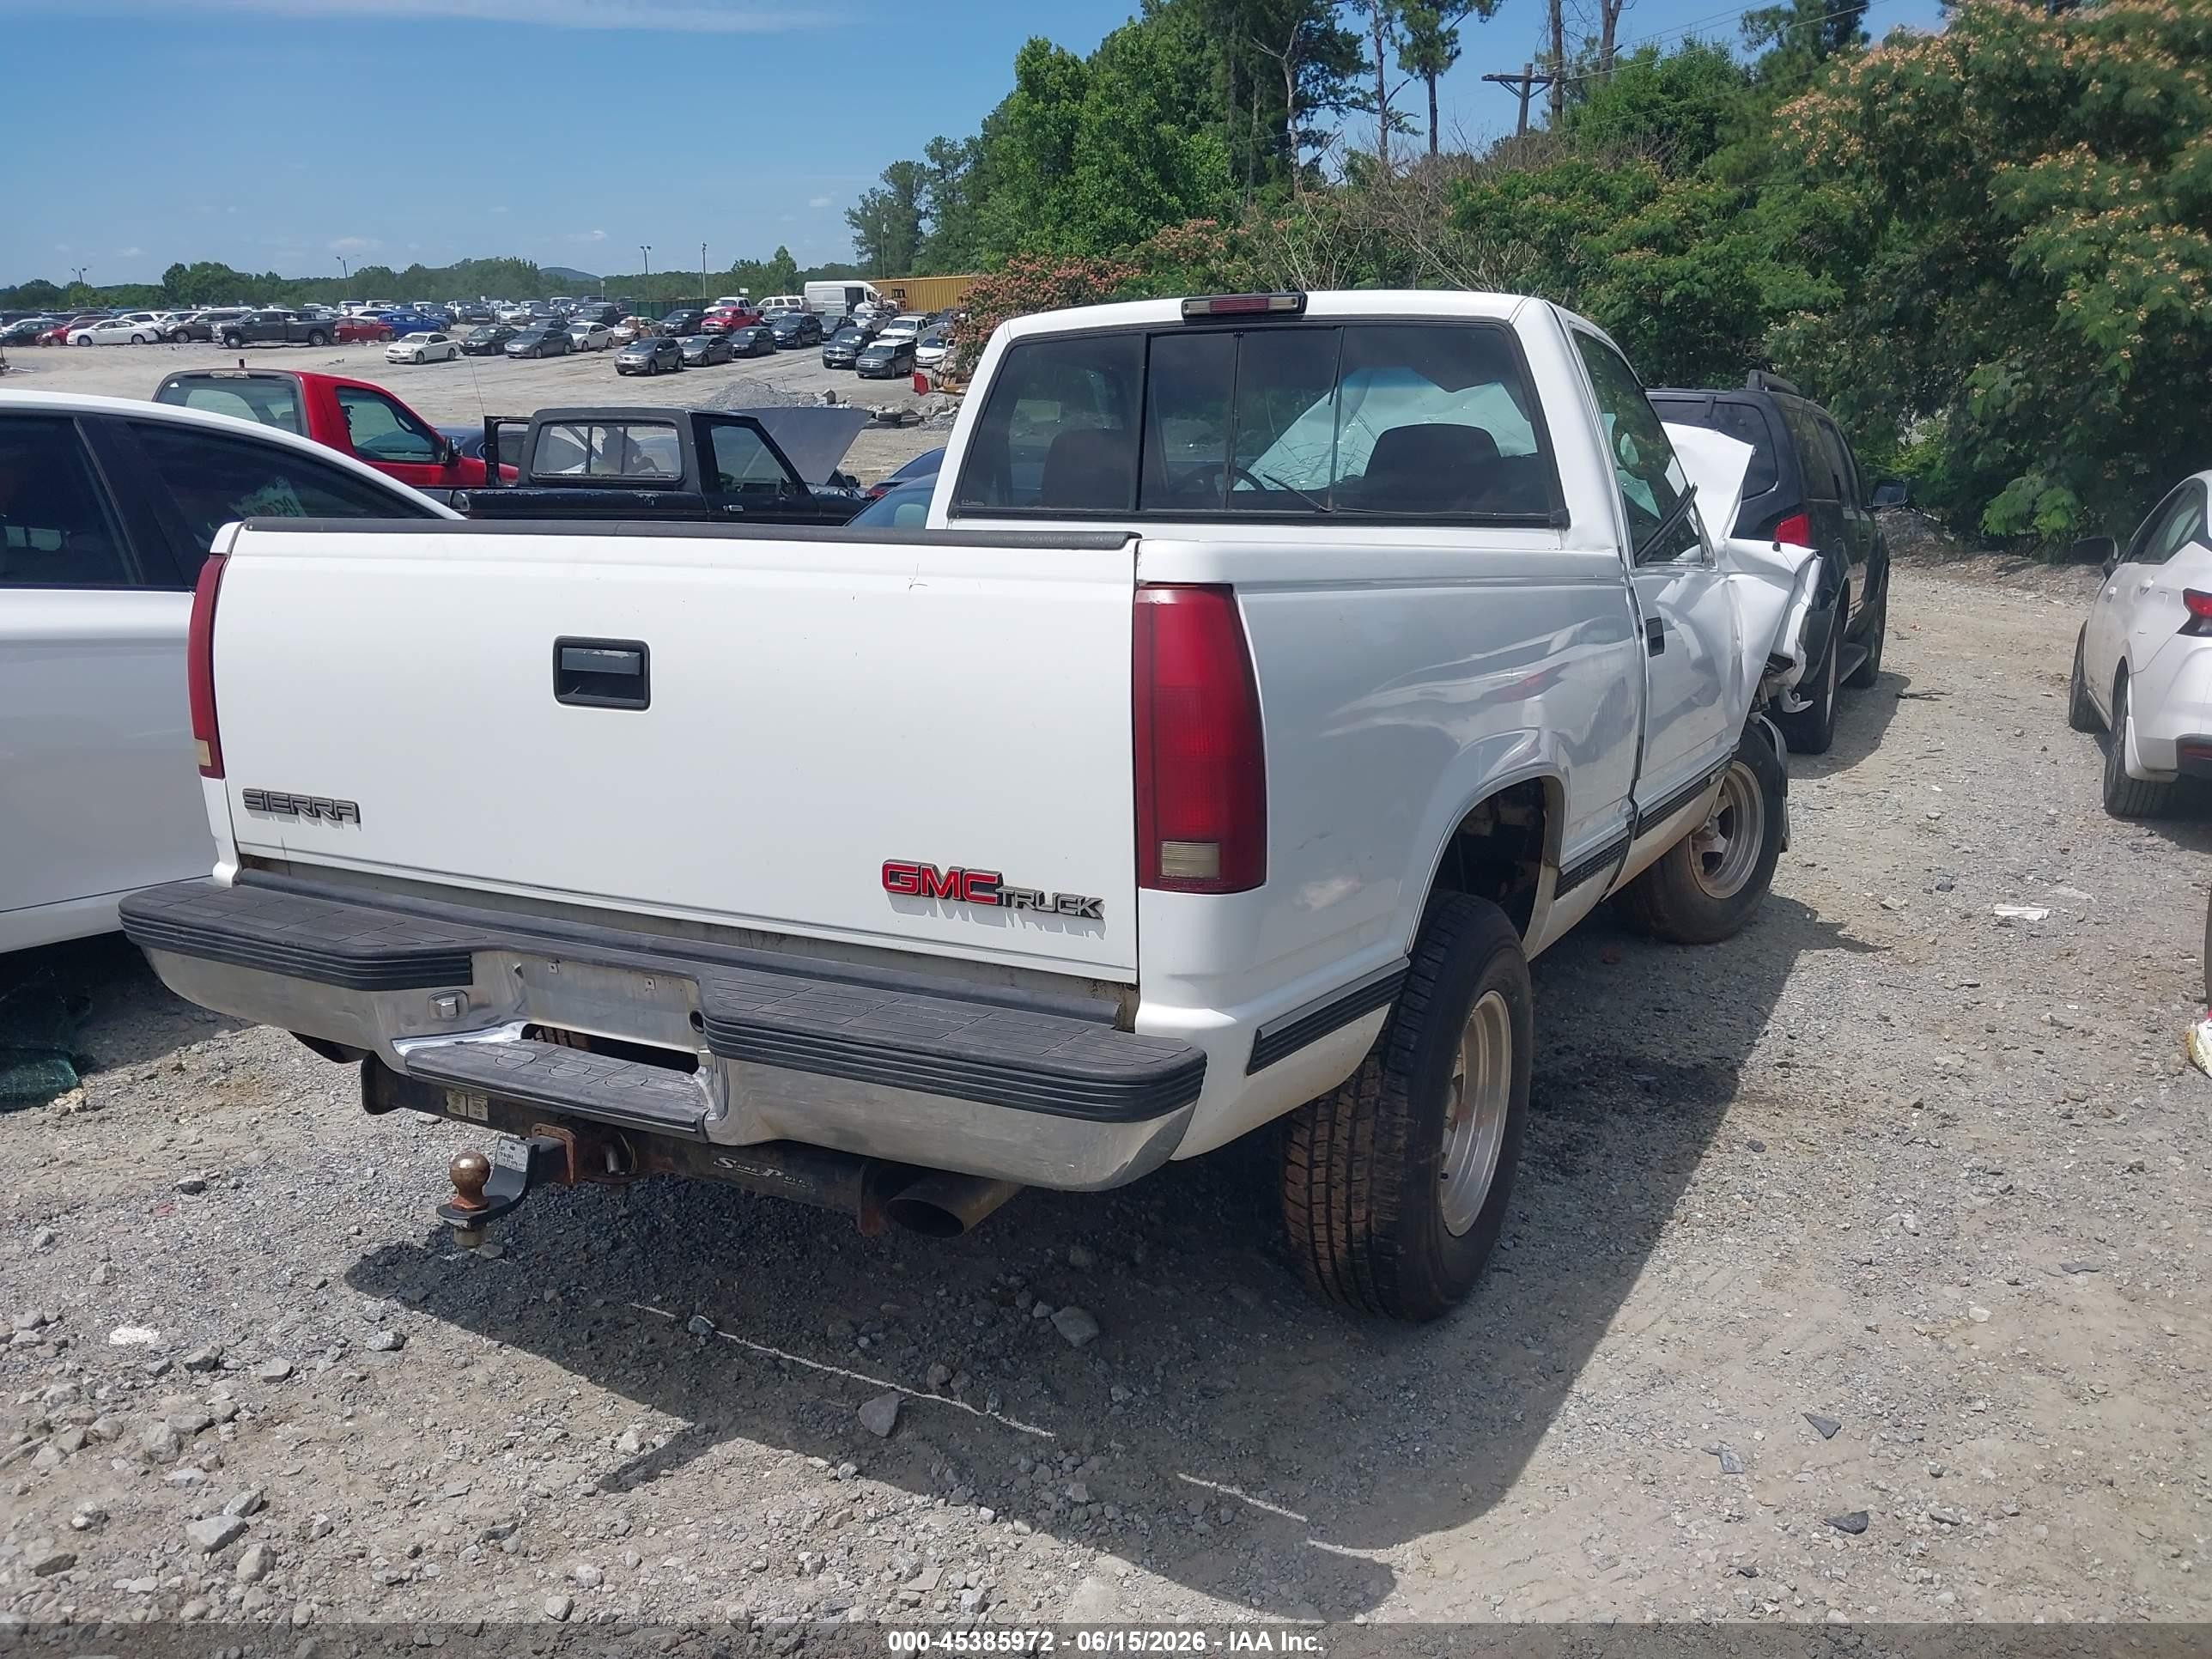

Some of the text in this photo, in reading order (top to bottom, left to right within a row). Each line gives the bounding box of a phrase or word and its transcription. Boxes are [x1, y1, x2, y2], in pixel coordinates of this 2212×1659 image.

[242, 788, 362, 823] SIERRA
[882, 859, 1106, 920] GMC TRUCK
